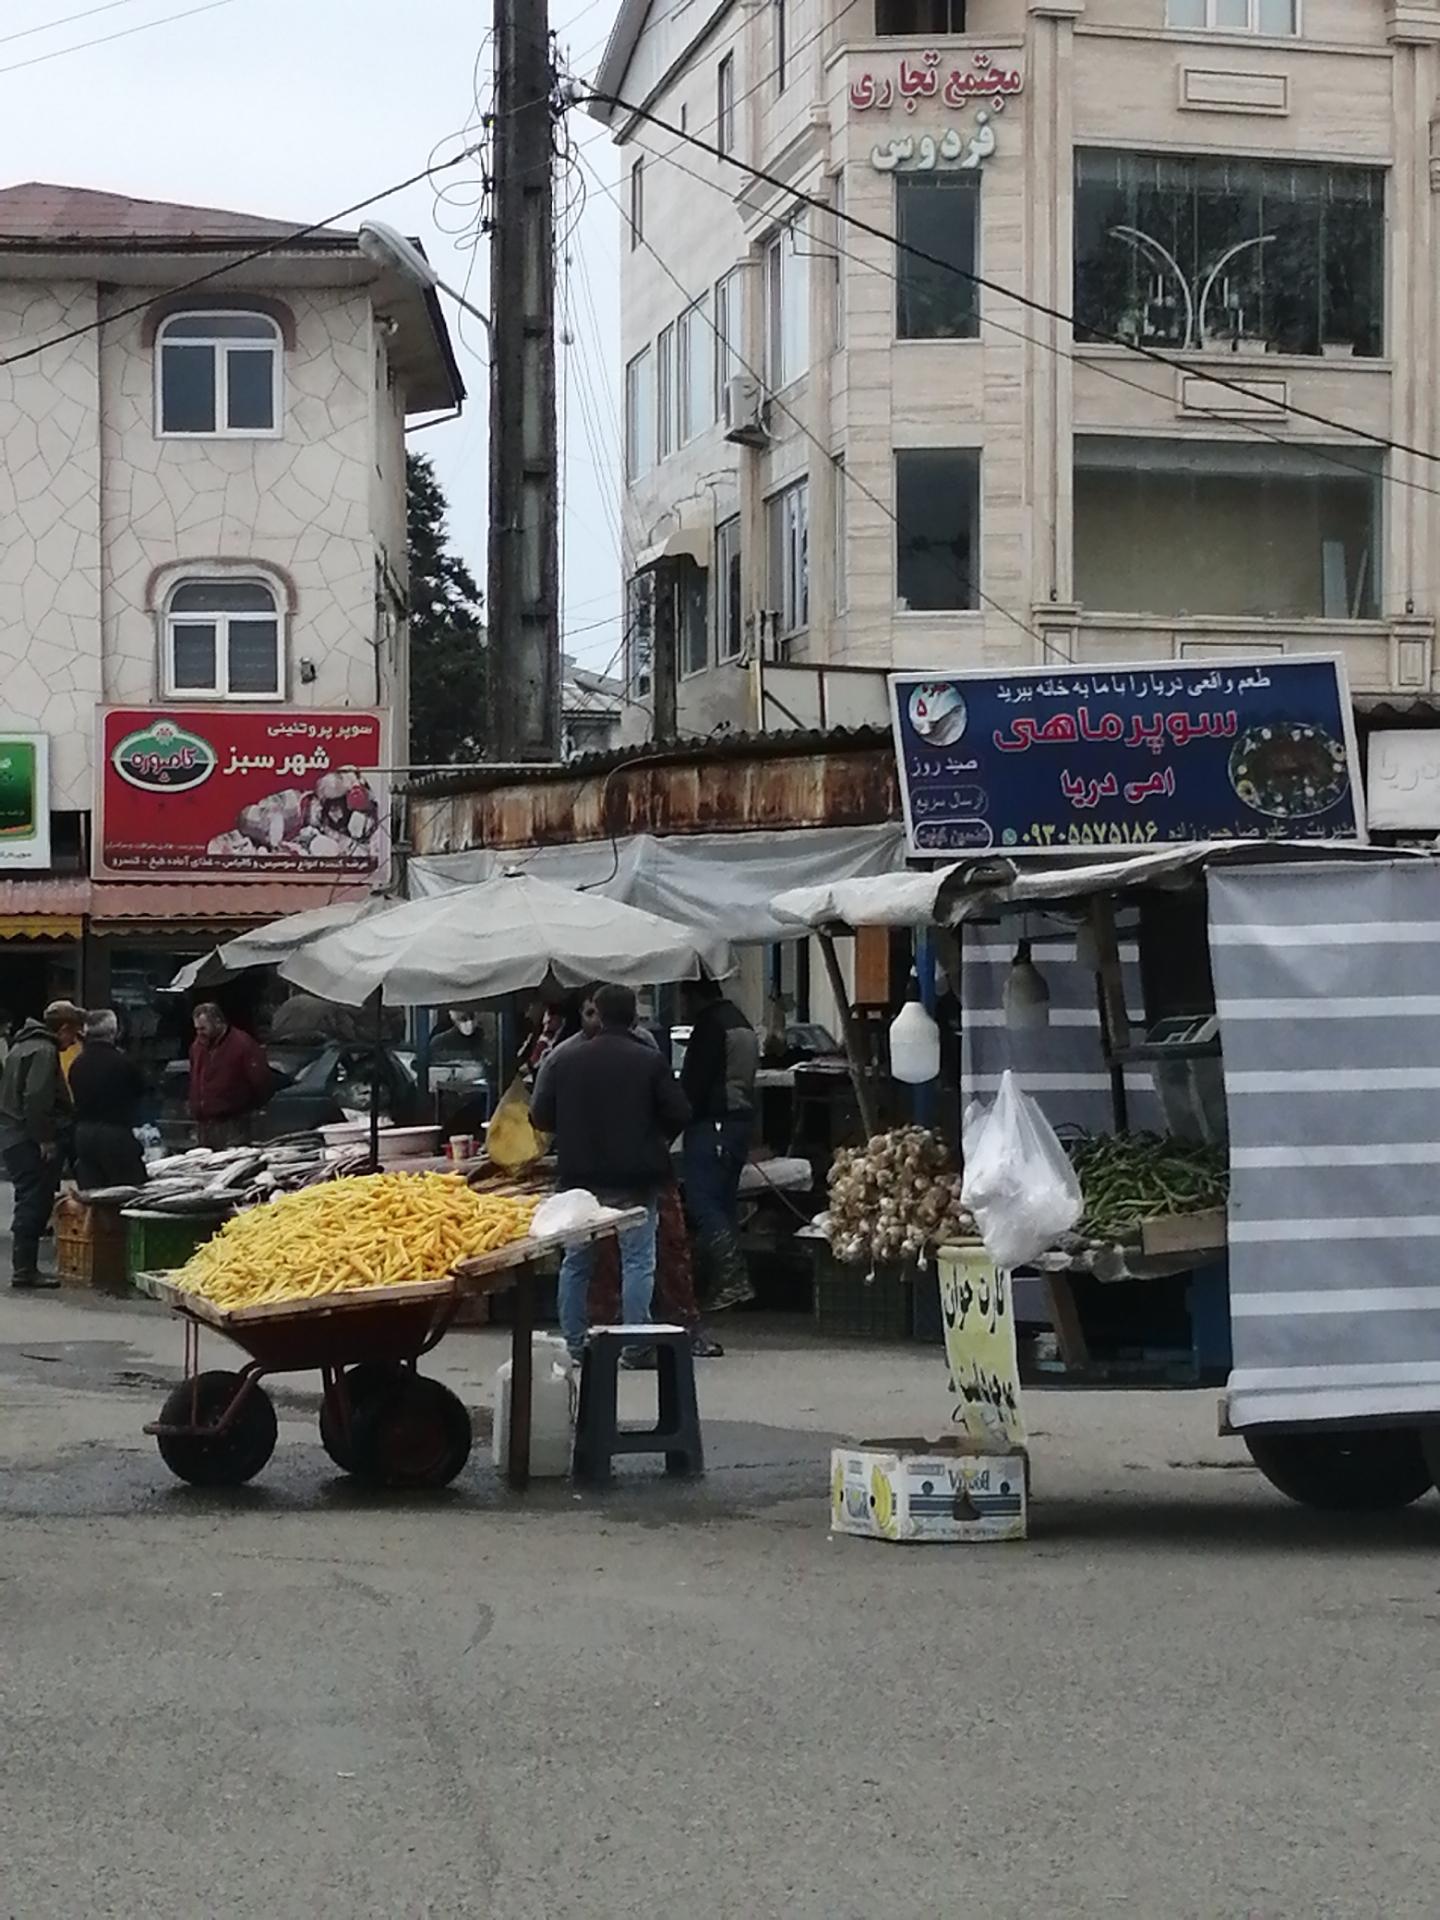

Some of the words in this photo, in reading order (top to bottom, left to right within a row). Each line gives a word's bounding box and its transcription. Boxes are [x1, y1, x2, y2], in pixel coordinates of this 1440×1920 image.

[849, 49, 940, 114] تجاری
[943, 52, 1024, 111] مجتمع
[871, 111, 996, 170] فردوس
[1037, 678, 1069, 696] خانه
[1073, 682, 1088, 699] به
[1092, 677, 1108, 695] ما
[1113, 676, 1125, 698] با
[1130, 675, 1146, 697] را
[1150, 674, 1182, 696] دریا
[1187, 671, 1233, 697] واقعی
[1238, 668, 1271, 691] طعم
[997, 682, 1033, 703] ببرید
[335, 724, 373, 740] سوپر
[993, 706, 1124, 752] ماهی
[1124, 709, 1238, 754] سوپر
[223, 745, 275, 775] سبز
[276, 745, 330, 776] شهر
[912, 757, 941, 776] روز
[945, 757, 978, 775] صید
[1060, 769, 1119, 808] دریا
